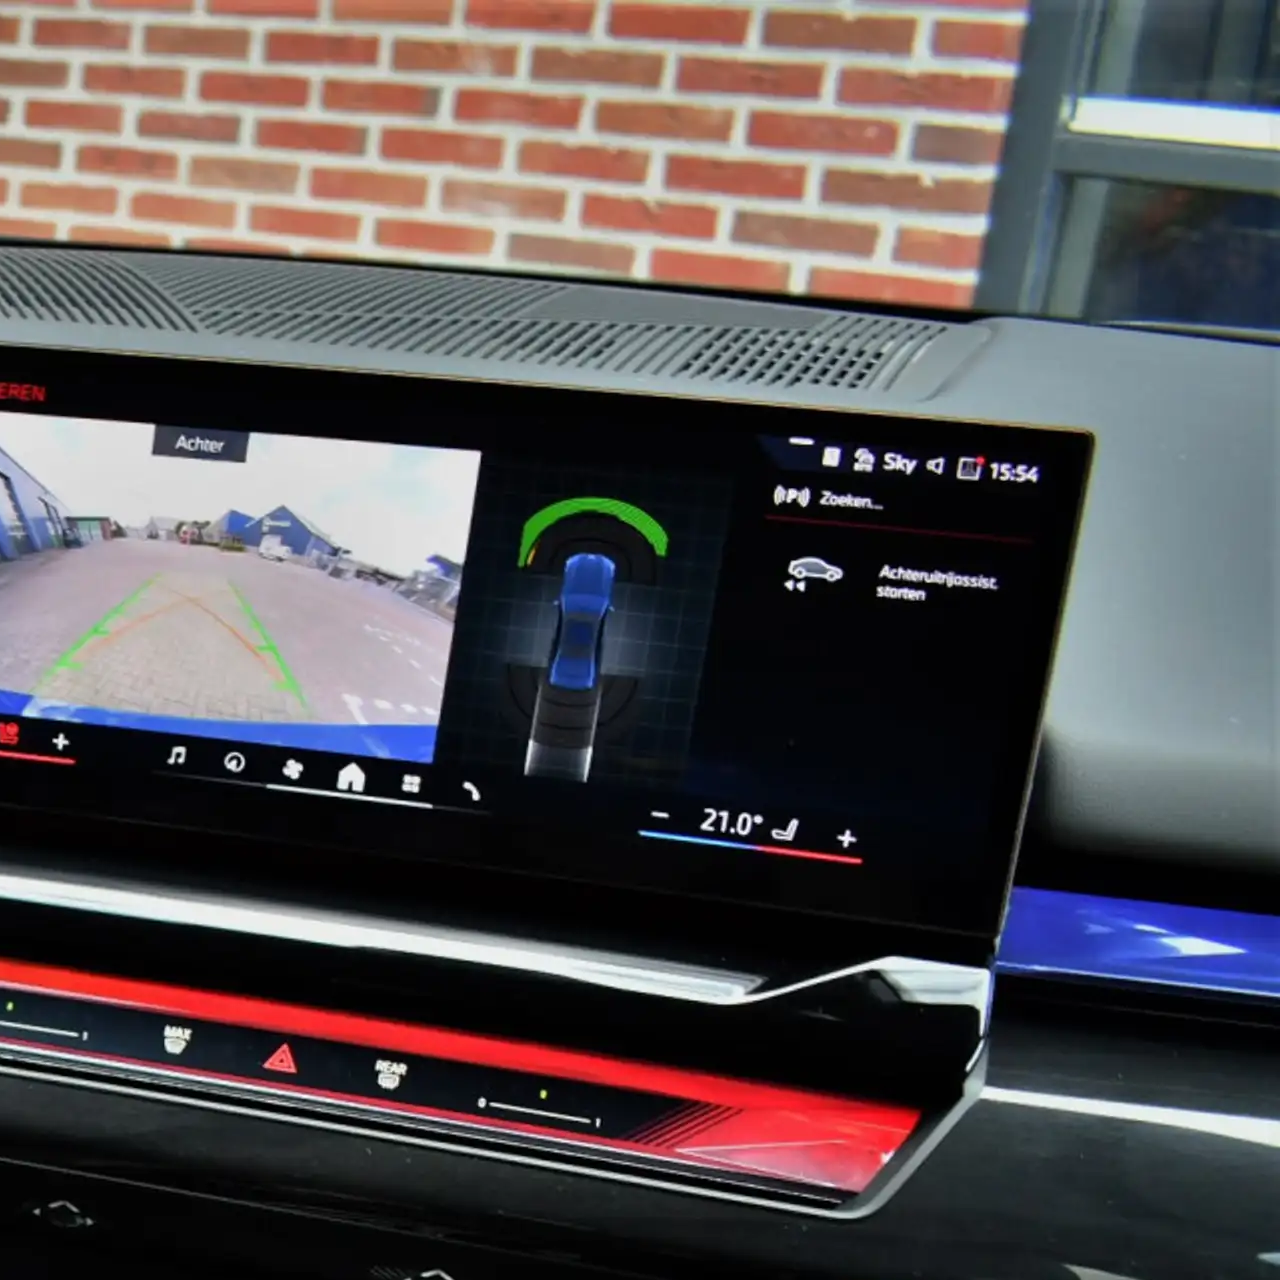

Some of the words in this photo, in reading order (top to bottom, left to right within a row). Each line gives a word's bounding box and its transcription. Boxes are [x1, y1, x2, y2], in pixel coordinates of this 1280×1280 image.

[174, 434, 225, 453] Achter
[883, 452, 917, 475] Sky
[989, 462, 1039, 483] 15:54
[375, 1059, 408, 1076] REAR
